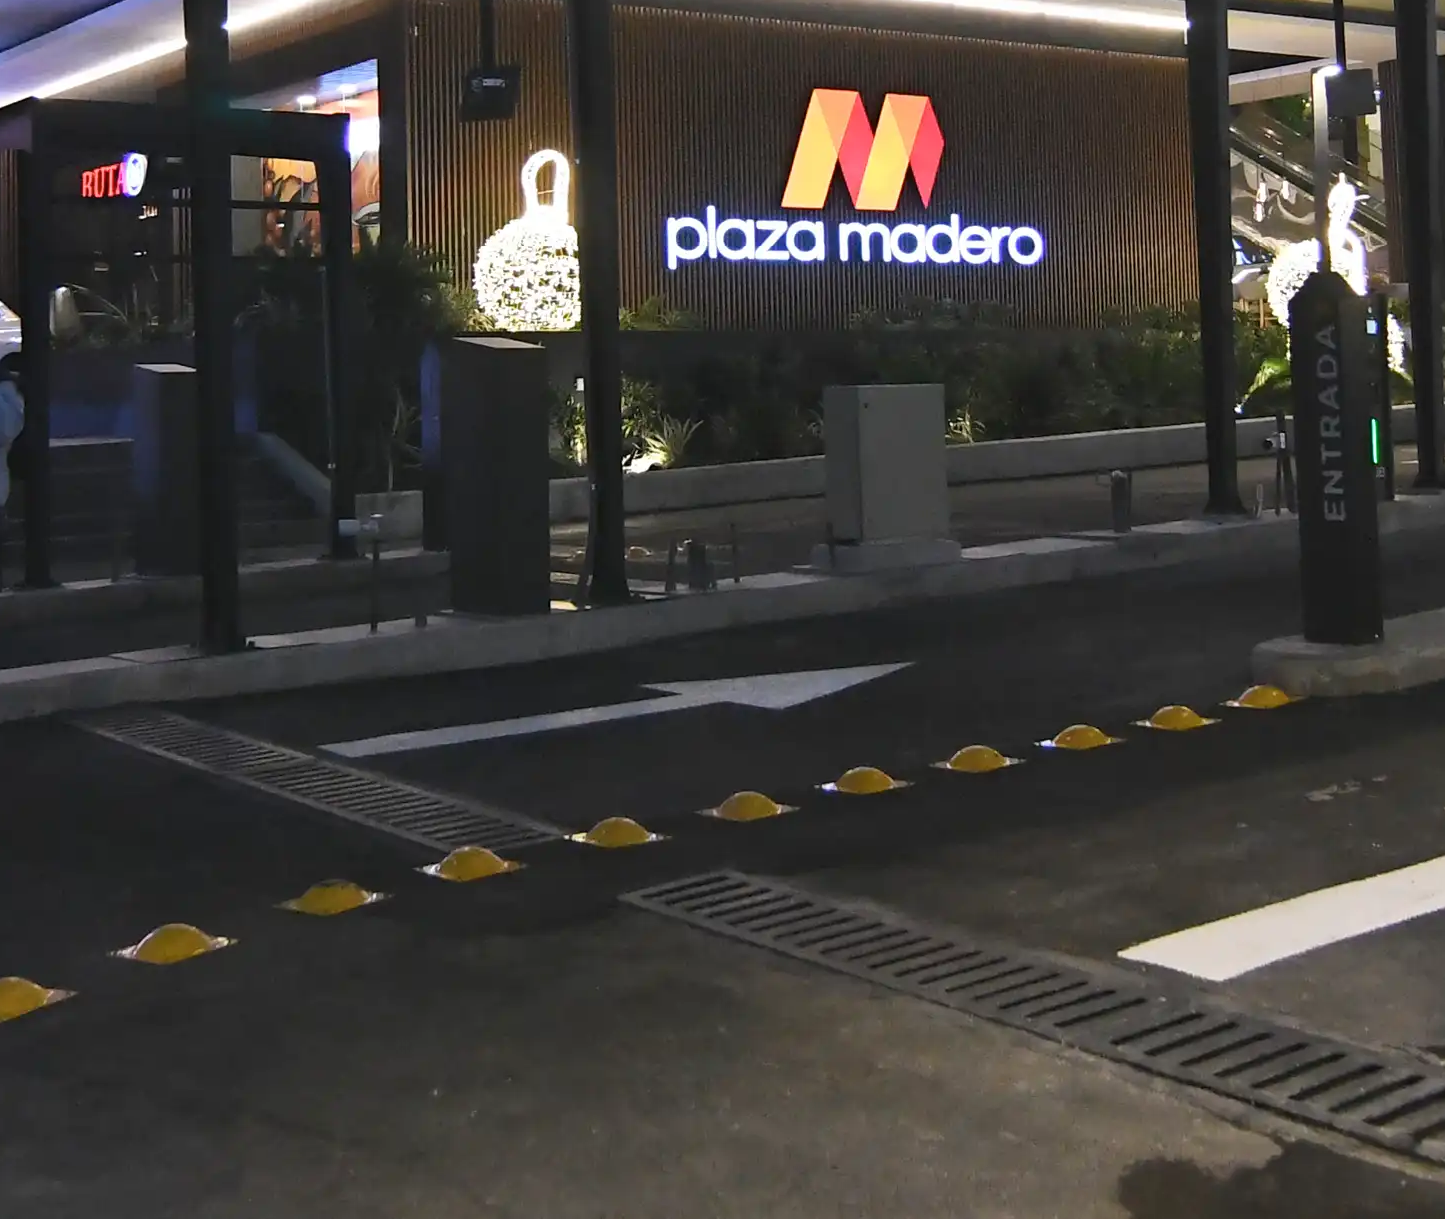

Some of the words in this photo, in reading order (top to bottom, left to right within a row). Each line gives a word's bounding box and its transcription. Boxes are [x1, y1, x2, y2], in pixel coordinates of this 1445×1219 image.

[81, 161, 127, 199] RUTA
[666, 205, 826, 271] plaza
[839, 213, 1046, 267] madero
[1315, 323, 1347, 522] ENTRADA
